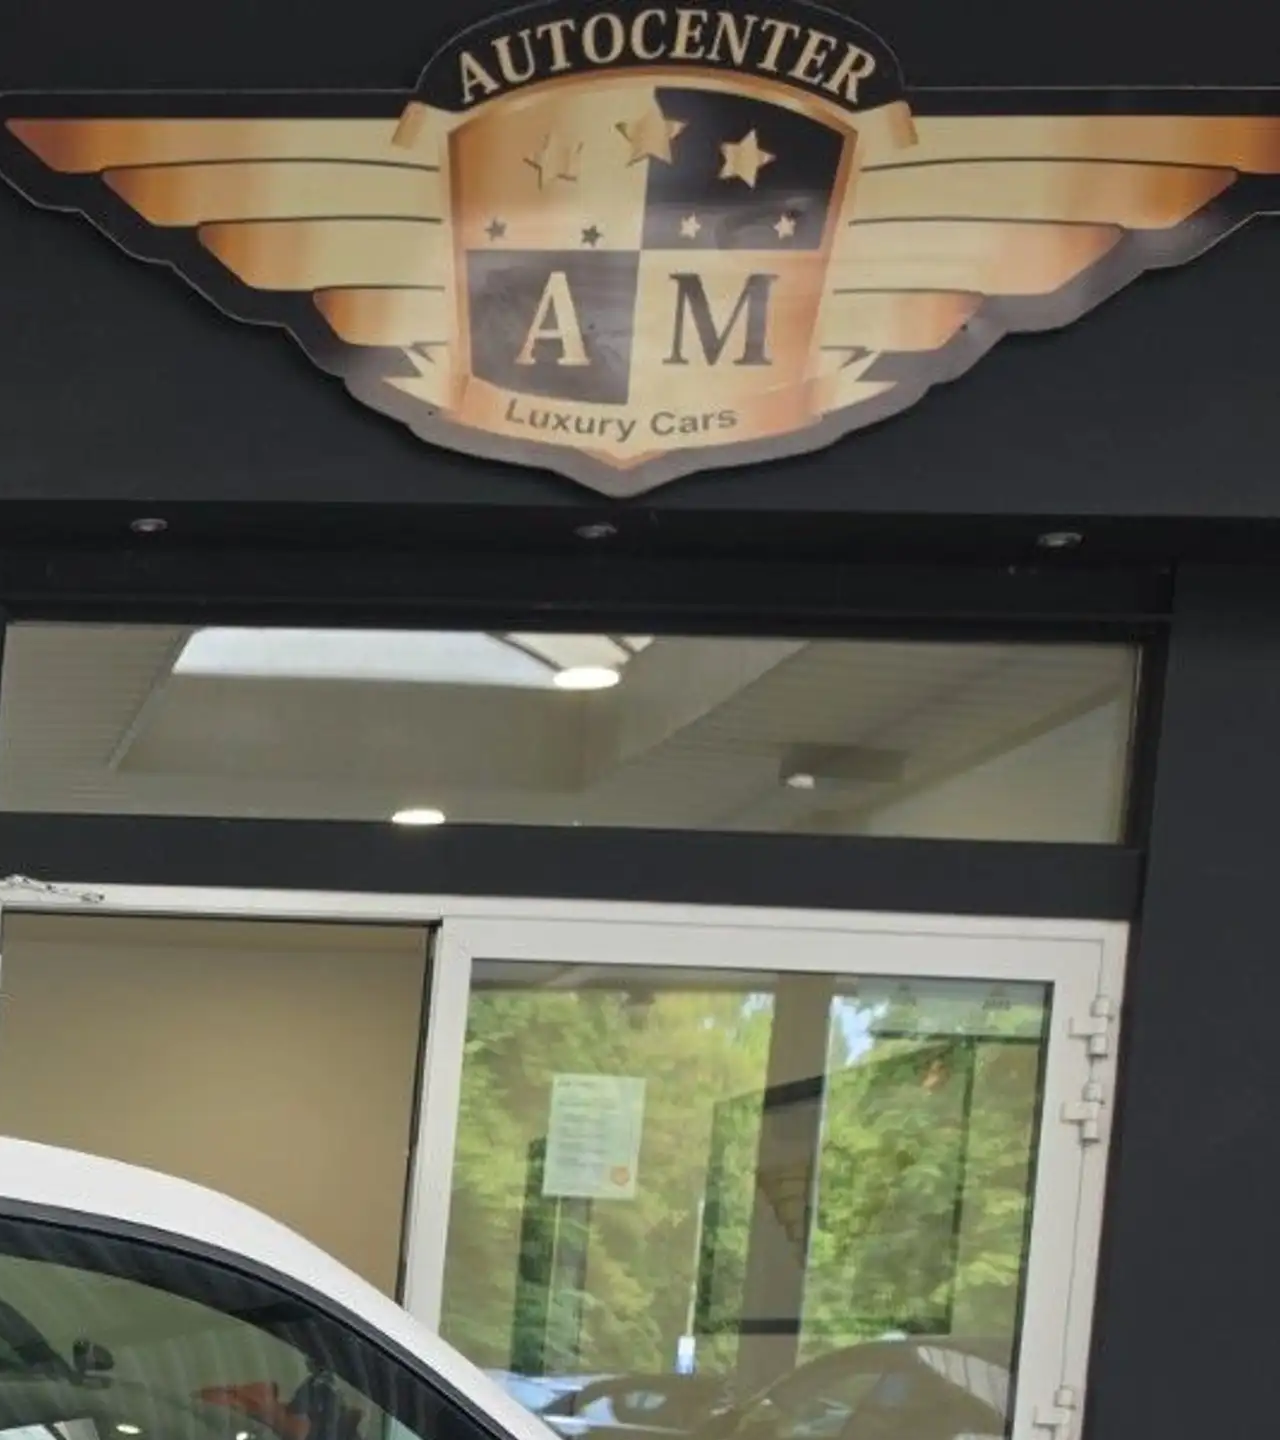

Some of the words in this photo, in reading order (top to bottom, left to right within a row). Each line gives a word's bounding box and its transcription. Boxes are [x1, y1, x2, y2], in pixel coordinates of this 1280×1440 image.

[458, 8, 877, 103] AUTOCENTER
[515, 271, 590, 365] A
[661, 272, 779, 366] M
[505, 399, 636, 443] Luxury
[650, 409, 738, 436] Cars
